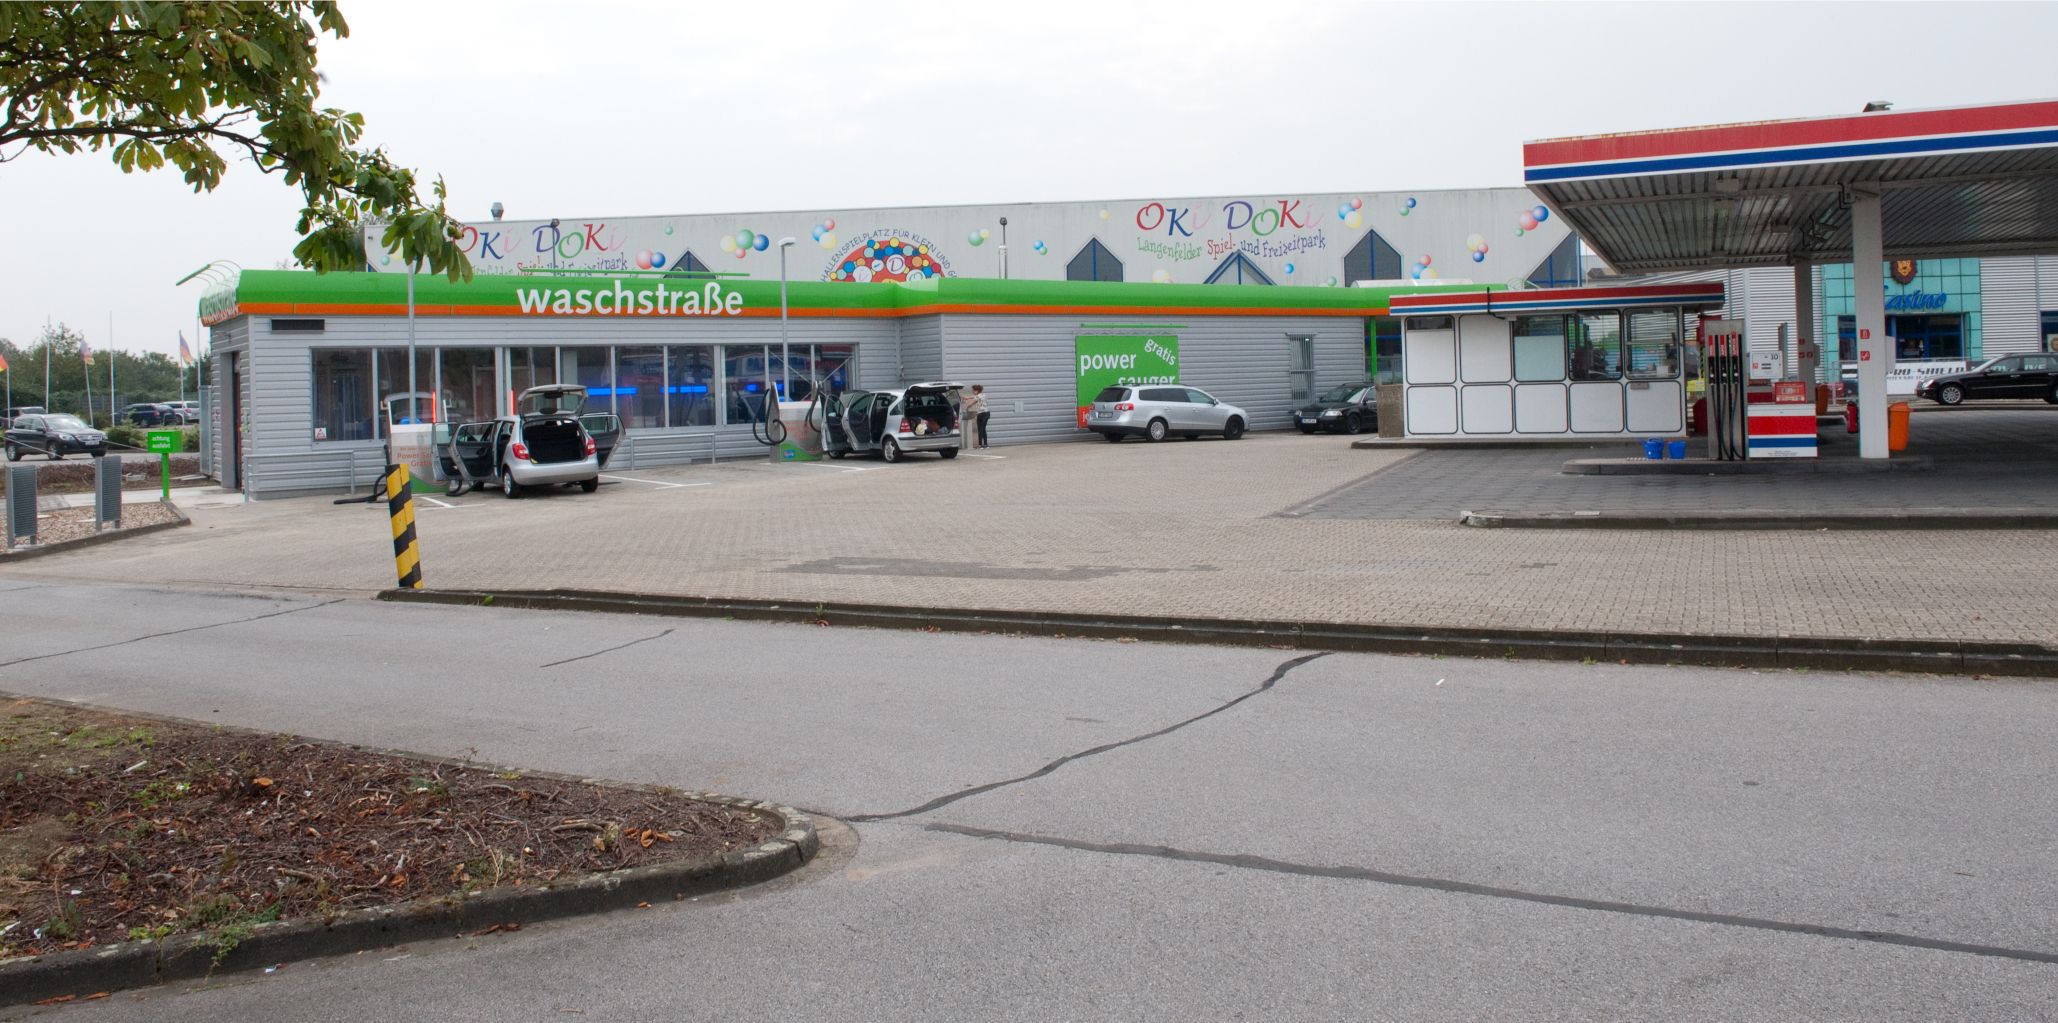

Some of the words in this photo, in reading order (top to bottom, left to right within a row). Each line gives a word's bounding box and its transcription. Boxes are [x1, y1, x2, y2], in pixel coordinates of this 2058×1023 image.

[820, 229, 890, 282] HALLENSPIELPLATZ
[911, 234, 937, 253] KLEIN
[936, 251, 951, 270] UND
[1137, 237, 1202, 262] Langenfelder
[1240, 239, 1260, 256] und
[1262, 229, 1326, 257] Freizeitpark
[517, 279, 743, 315] waschstraße
[1884, 285, 1947, 310] asino
[1080, 353, 1136, 376] power
[1144, 339, 1176, 366] gratis
